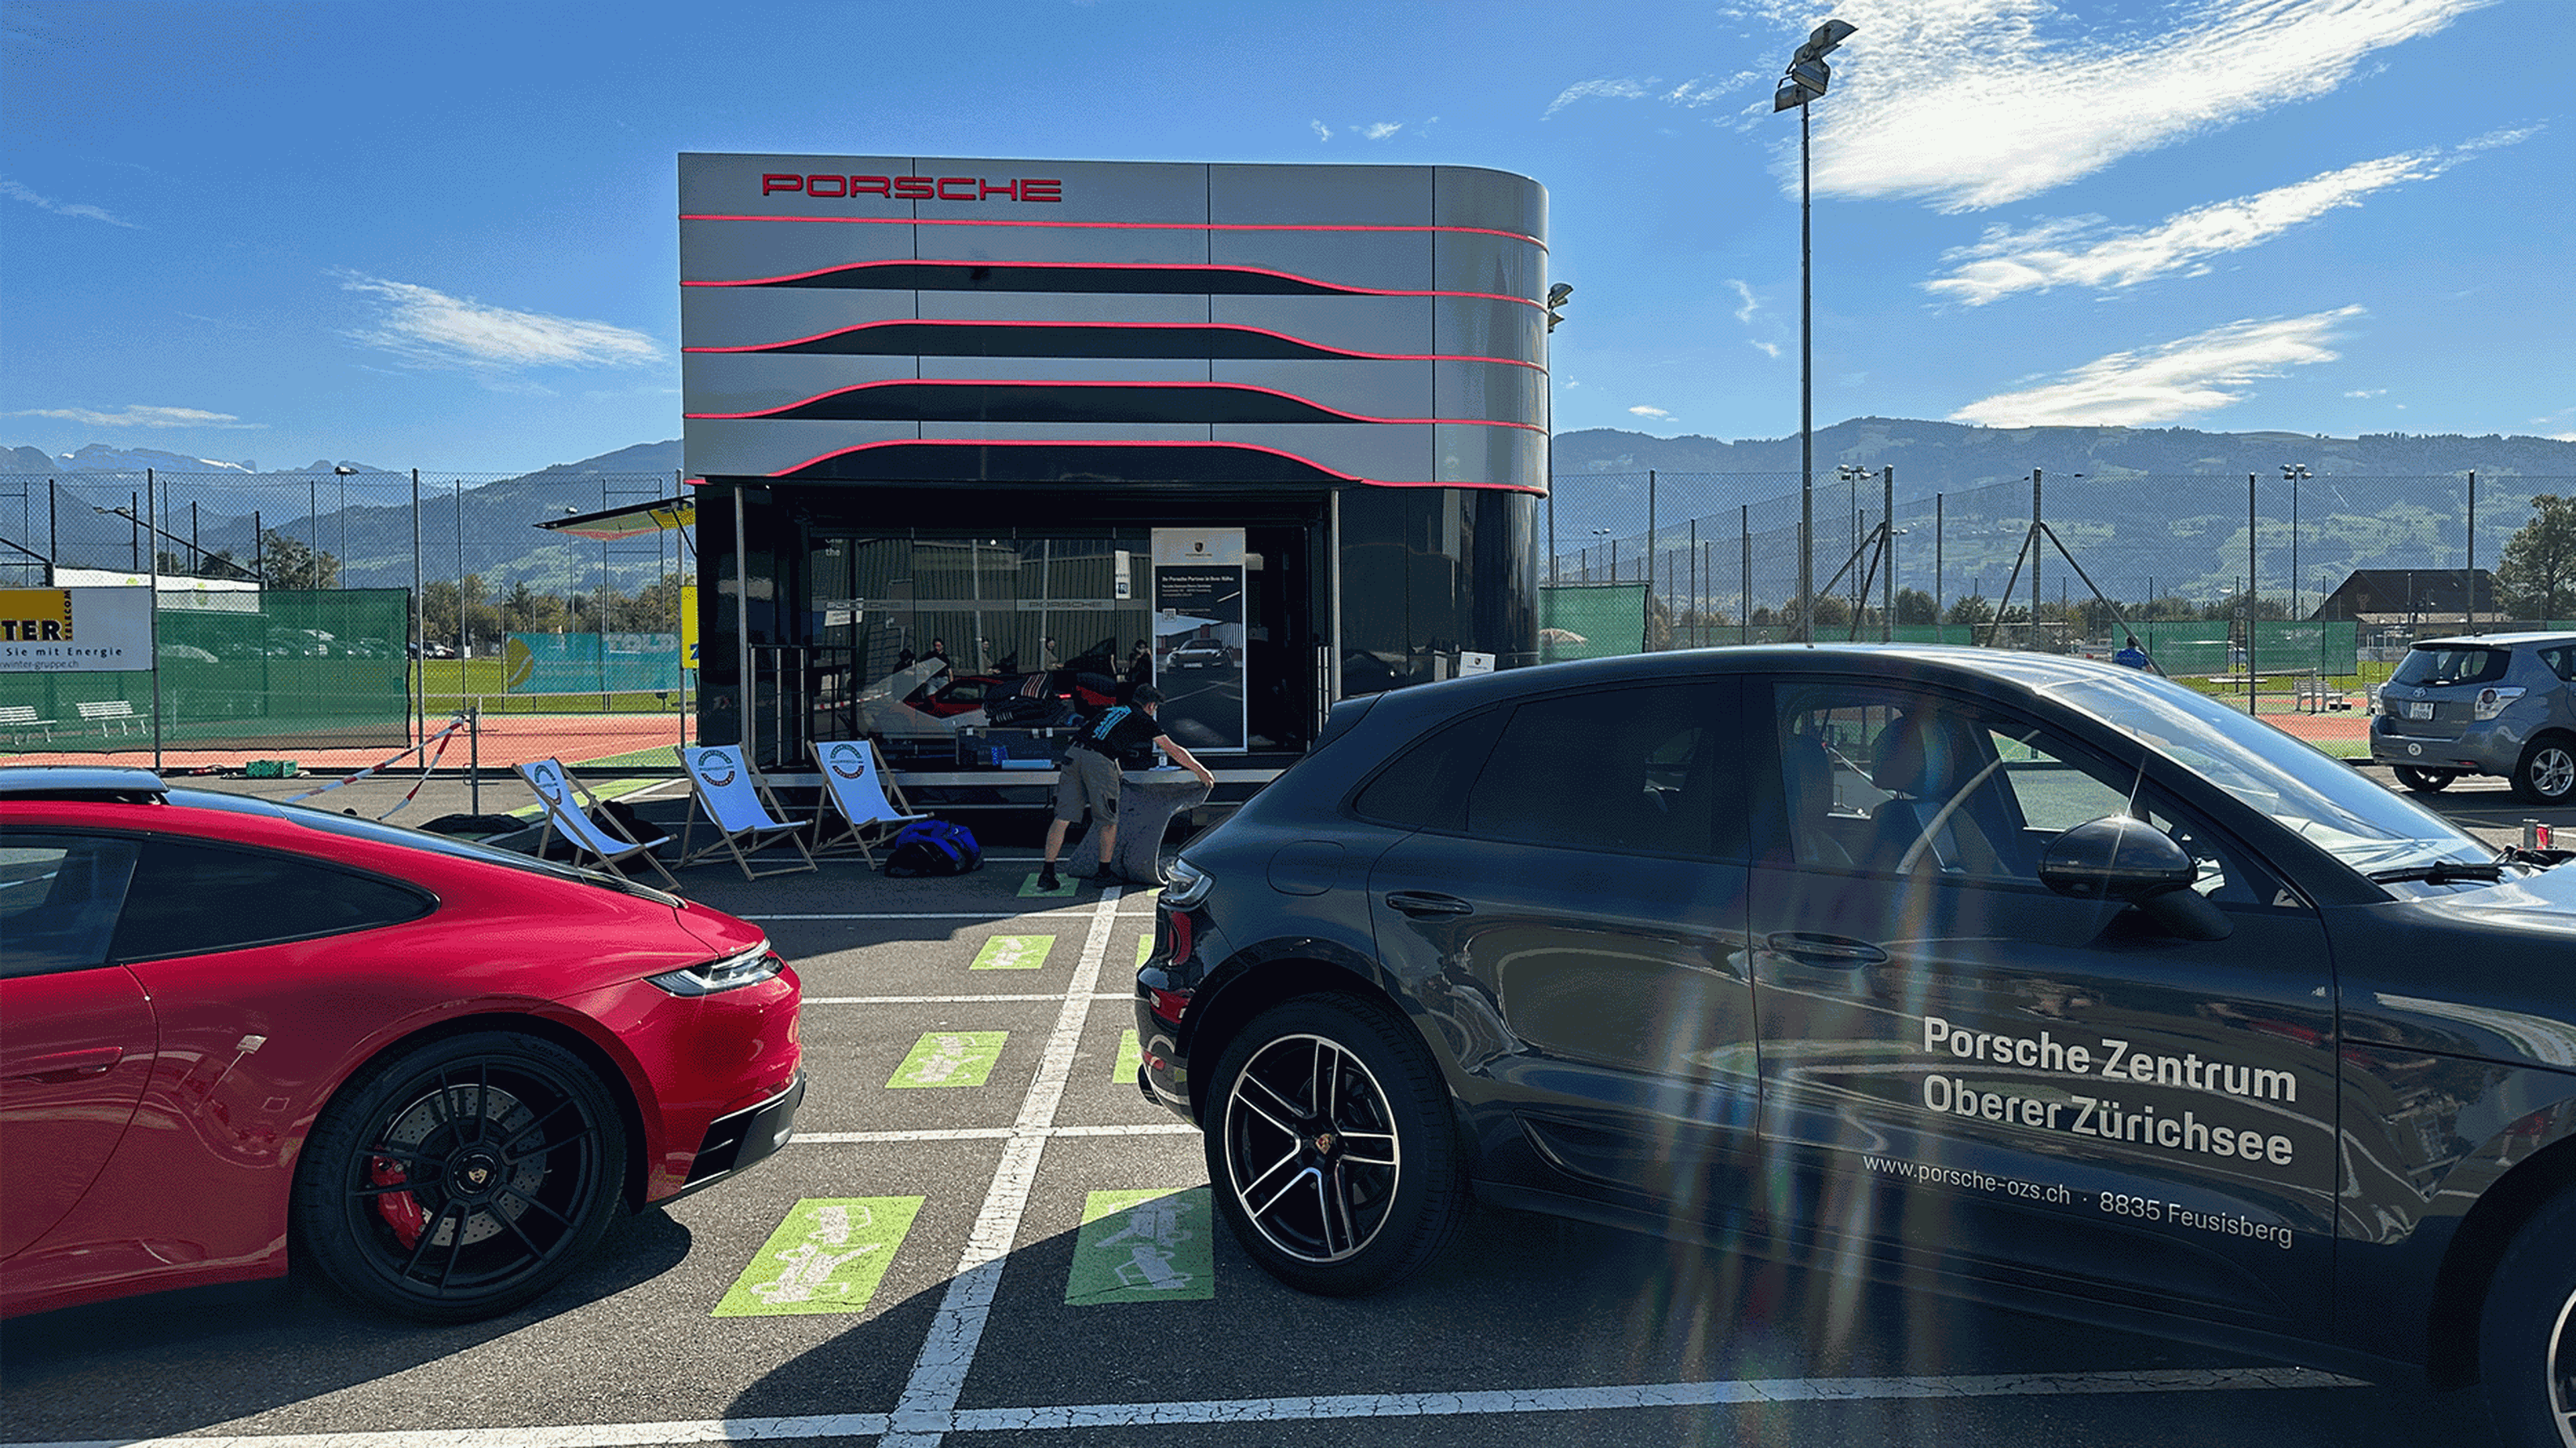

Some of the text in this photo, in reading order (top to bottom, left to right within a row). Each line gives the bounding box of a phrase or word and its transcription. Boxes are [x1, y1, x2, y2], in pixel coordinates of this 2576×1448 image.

[763, 173, 1062, 201] PORSCHE
[6, 647, 122, 658] Sie mit Energie
[1924, 1015, 2296, 1101] Porsche Zentrum
[1923, 1074, 2293, 1165] Oberer Zürichsee
[1863, 1156, 2292, 1249] www.porsche-ozs.ch 8835 Feusisberg
